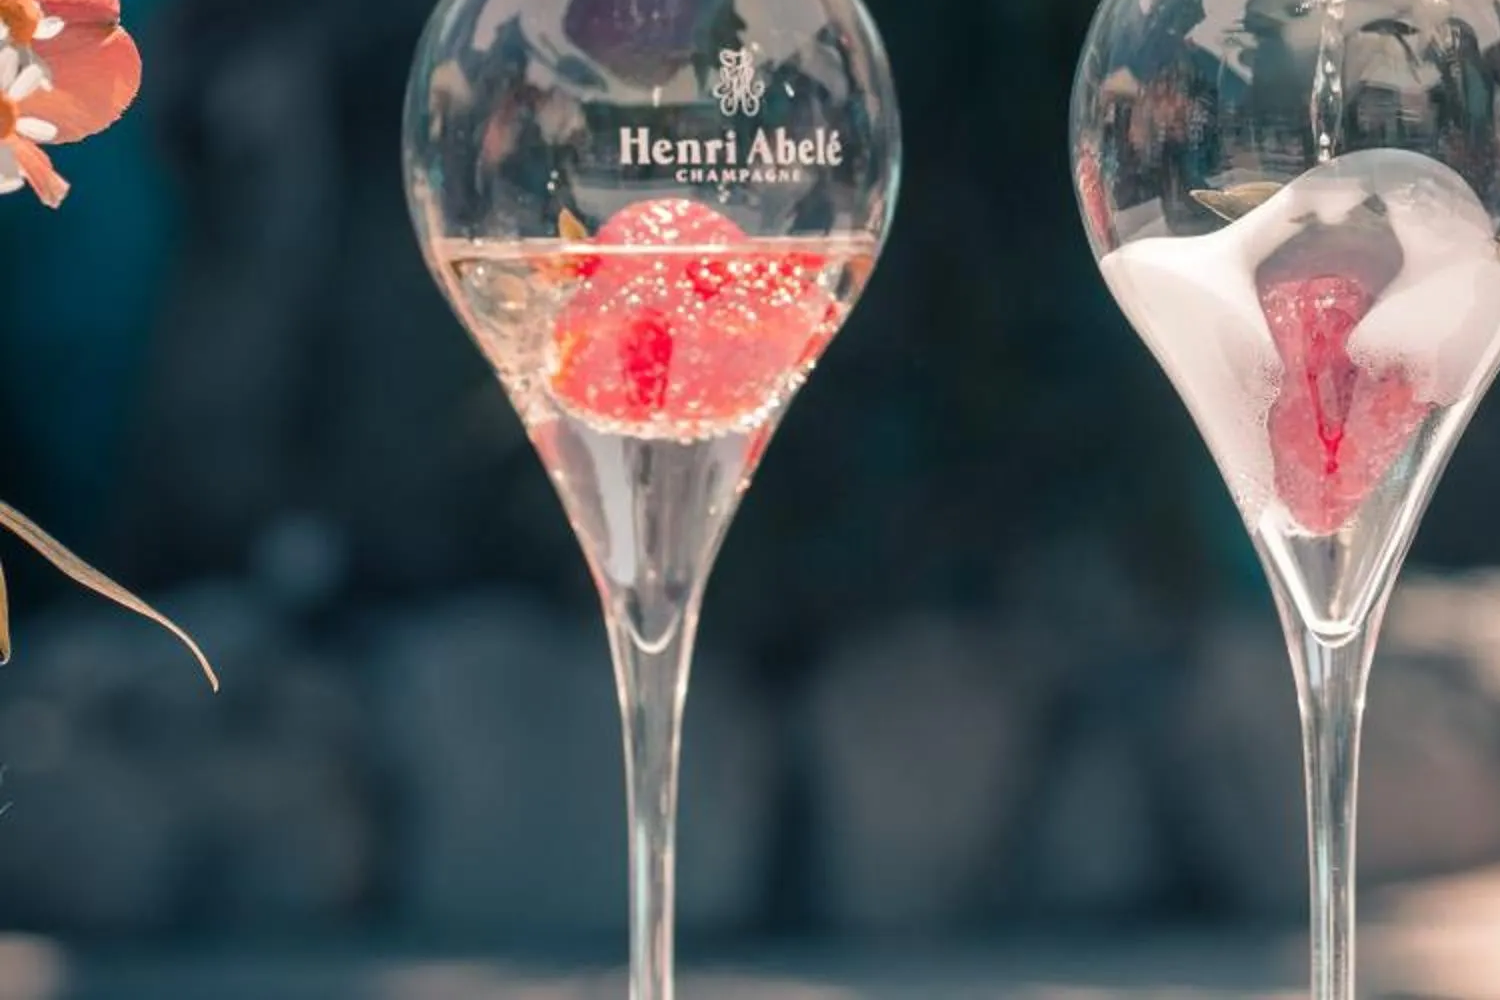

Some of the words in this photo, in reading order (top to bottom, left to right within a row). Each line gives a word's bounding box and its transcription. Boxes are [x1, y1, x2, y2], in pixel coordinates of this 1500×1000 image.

[619, 127, 737, 165] Henri
[748, 127, 842, 165] Abelé
[675, 168, 801, 182] CHAMPAGNE
